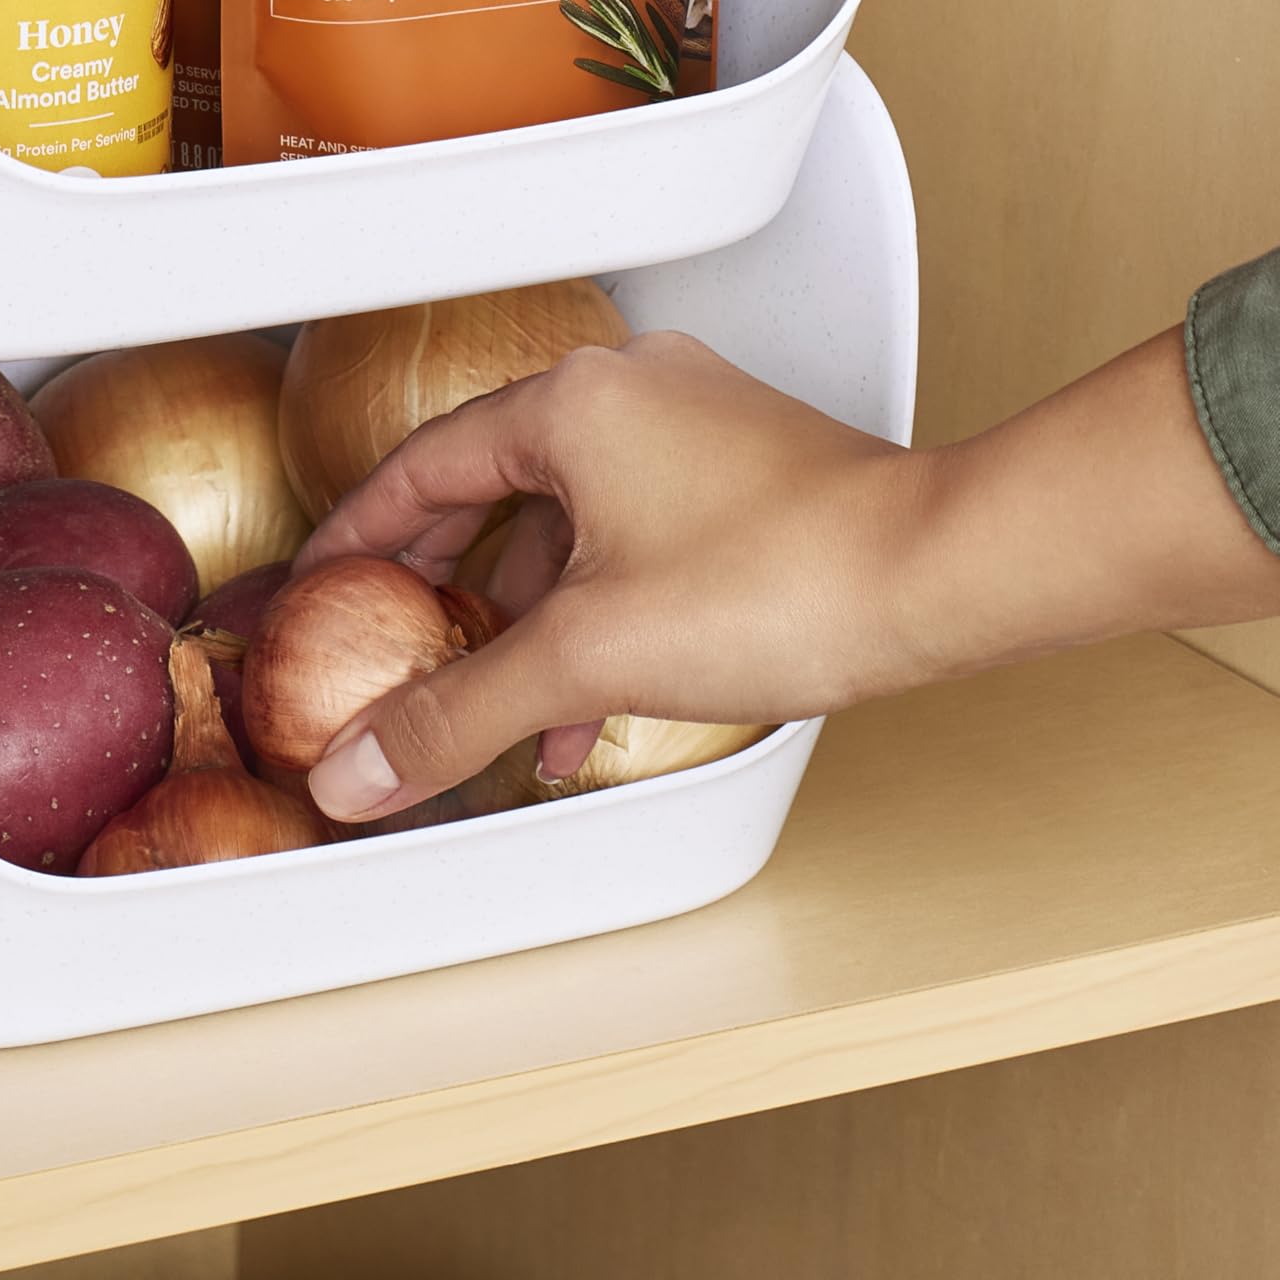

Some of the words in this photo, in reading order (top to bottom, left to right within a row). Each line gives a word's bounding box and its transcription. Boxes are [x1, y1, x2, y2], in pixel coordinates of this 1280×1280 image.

[16, 13, 125, 51] Honey
[31, 57, 113, 83] Creamy
[87, 74, 139, 102] Butter
[16, 141, 67, 157] Protein
[71, 138, 93, 152] Per
[95, 128, 136, 148] Serving
[280, 134, 315, 150] HEAT
[318, 140, 347, 154] AND
